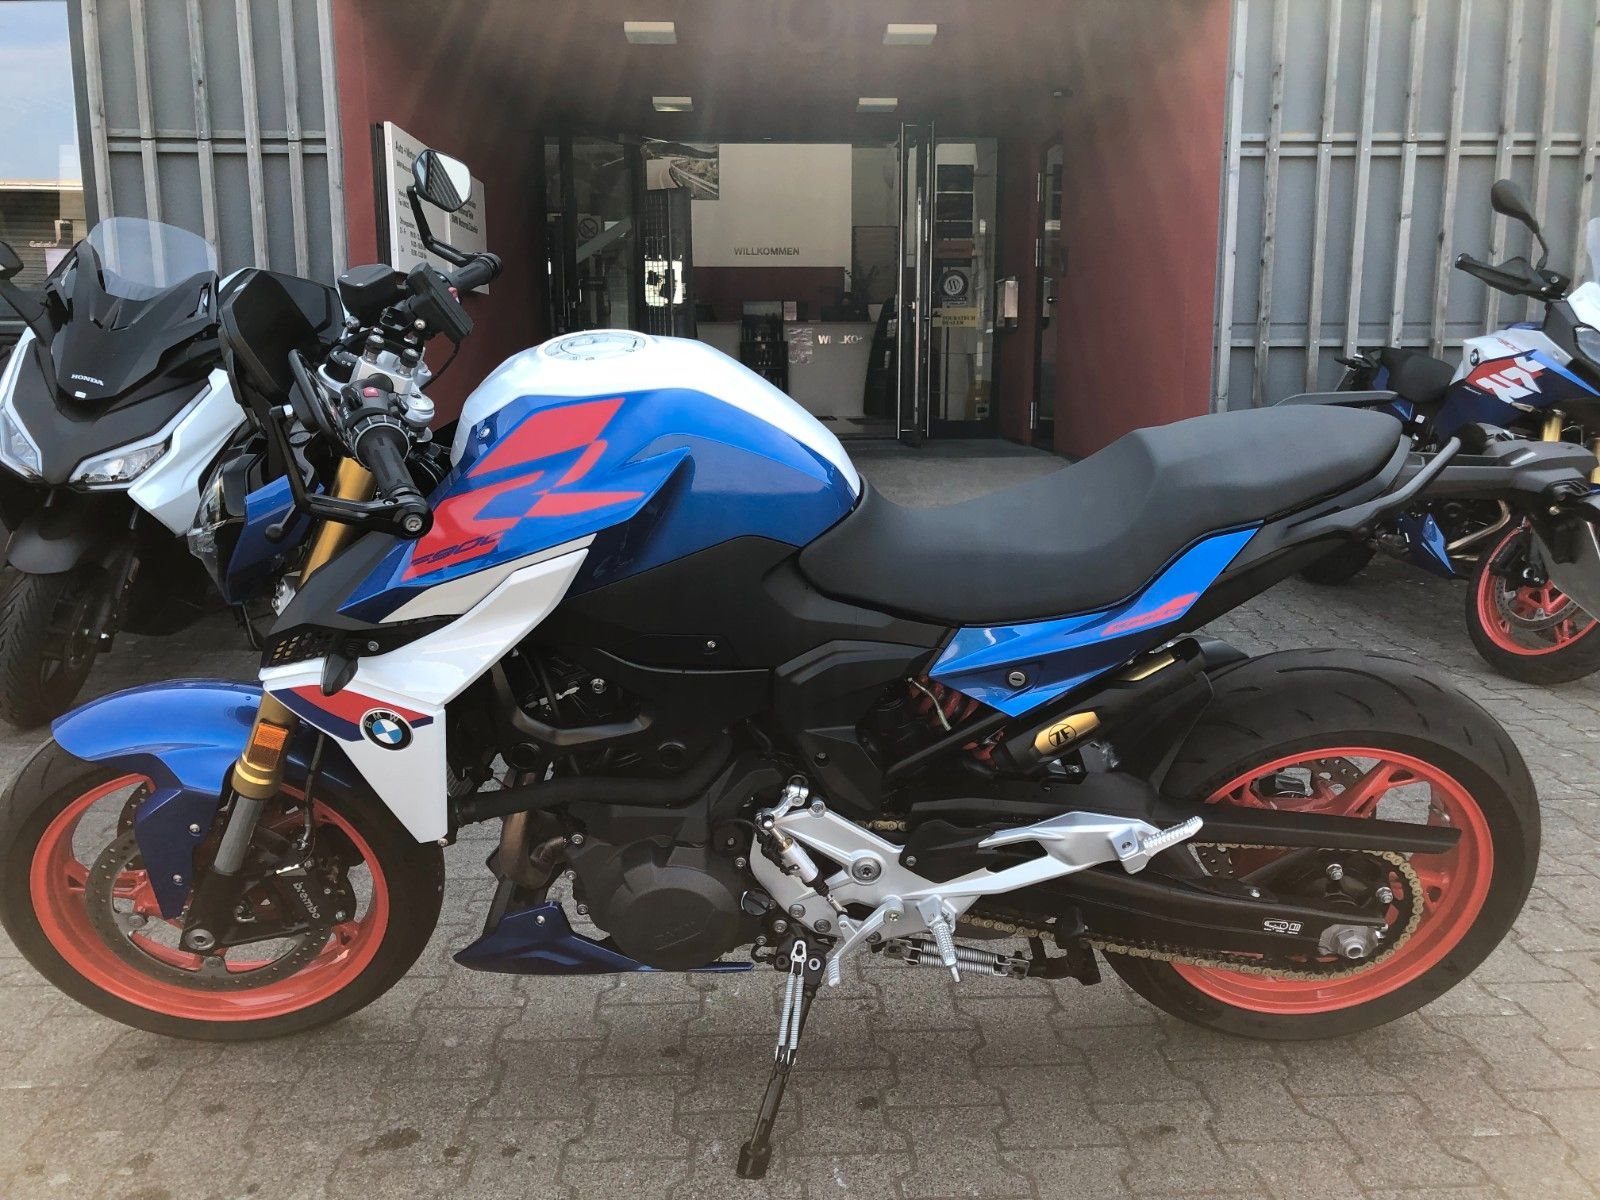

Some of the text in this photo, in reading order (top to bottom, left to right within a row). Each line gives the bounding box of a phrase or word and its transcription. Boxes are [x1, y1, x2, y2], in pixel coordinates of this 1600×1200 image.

[734, 247, 800, 256] WILLKOMMEN
[71, 373, 104, 387] HONDA
[292, 881, 321, 919] brembo
